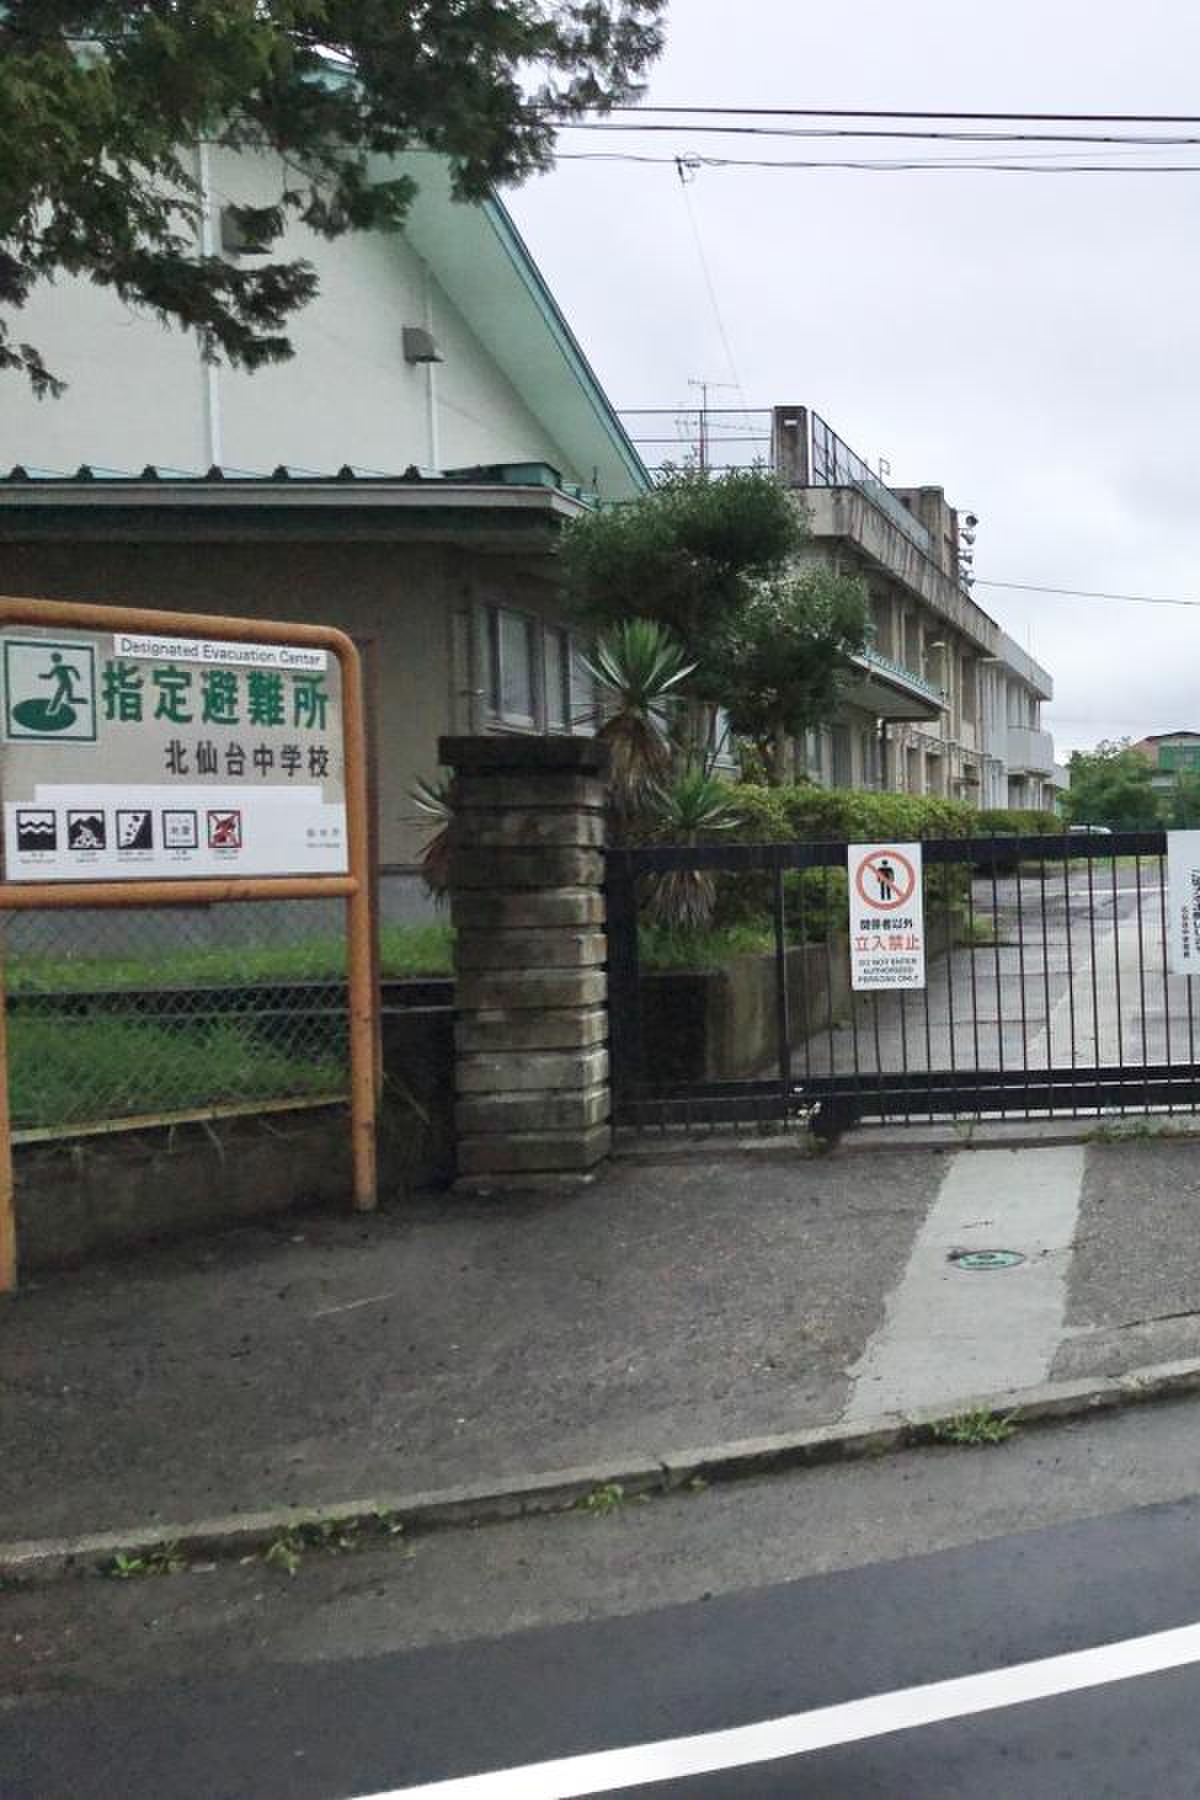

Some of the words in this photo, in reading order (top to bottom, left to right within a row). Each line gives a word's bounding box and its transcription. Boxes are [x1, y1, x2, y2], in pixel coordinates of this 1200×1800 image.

[121, 638, 199, 657] Designated
[203, 644, 279, 662] Evacuation
[280, 650, 321, 666] Center
[101, 661, 330, 730] 指定避難所
[165, 740, 330, 778] 北仙台中学校
[859, 918, 913, 931] 関係者以外
[855, 934, 921, 951] 立入禁止
